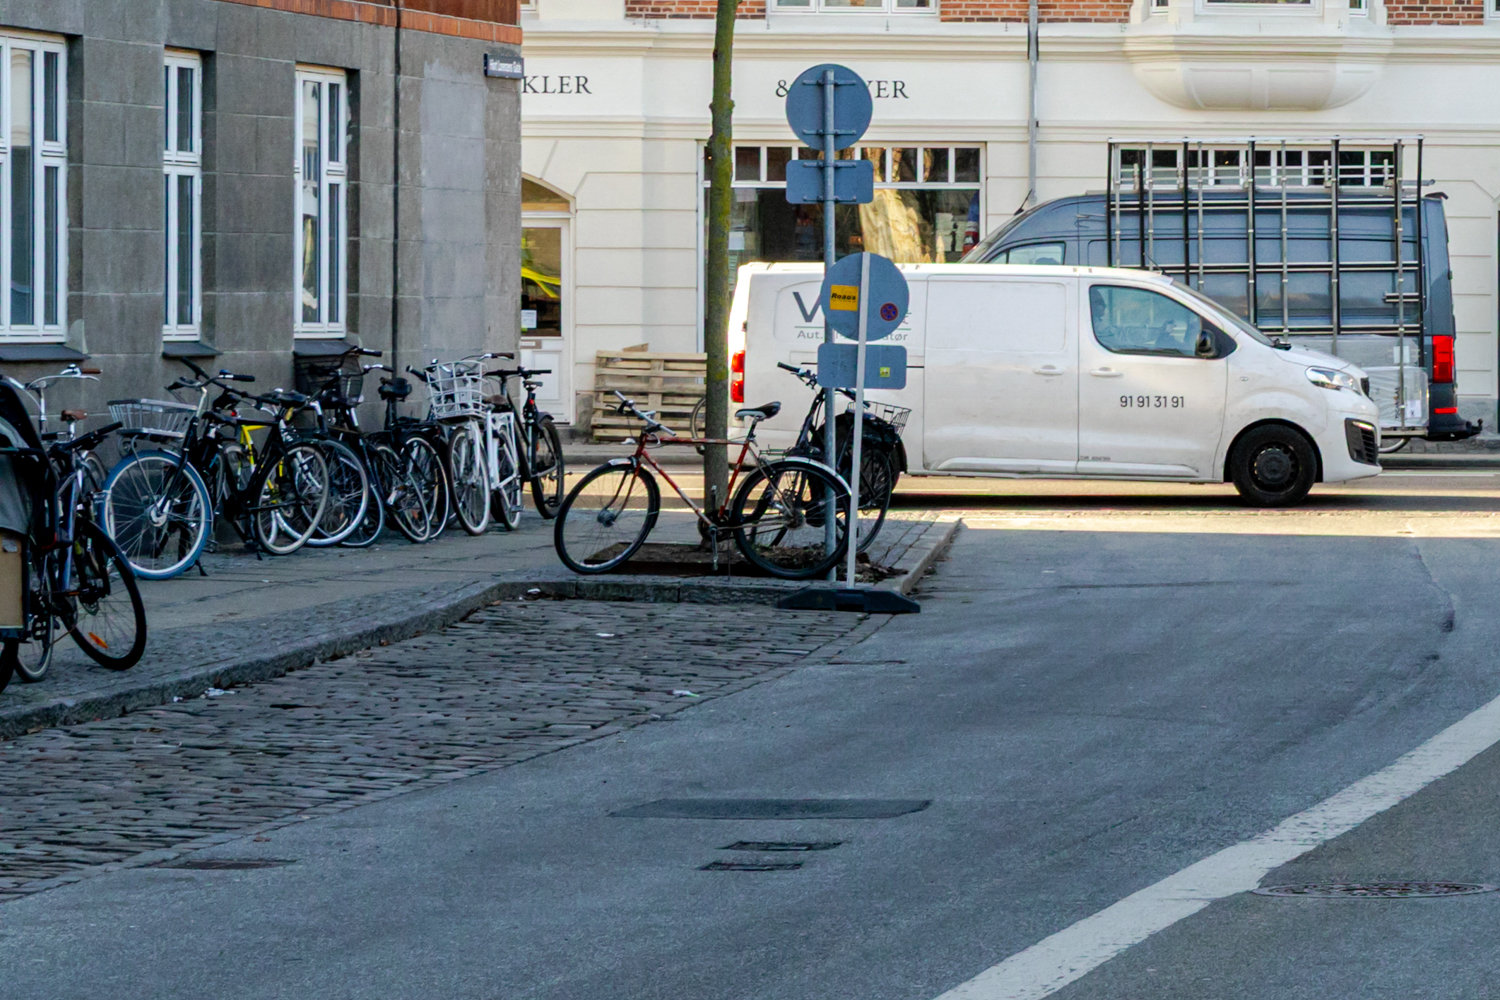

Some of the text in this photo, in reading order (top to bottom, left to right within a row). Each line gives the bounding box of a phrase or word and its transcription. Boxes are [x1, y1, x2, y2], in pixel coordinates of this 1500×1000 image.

[775, 79, 790, 97] &
[1120, 395, 1184, 408] 91 91 31 91
